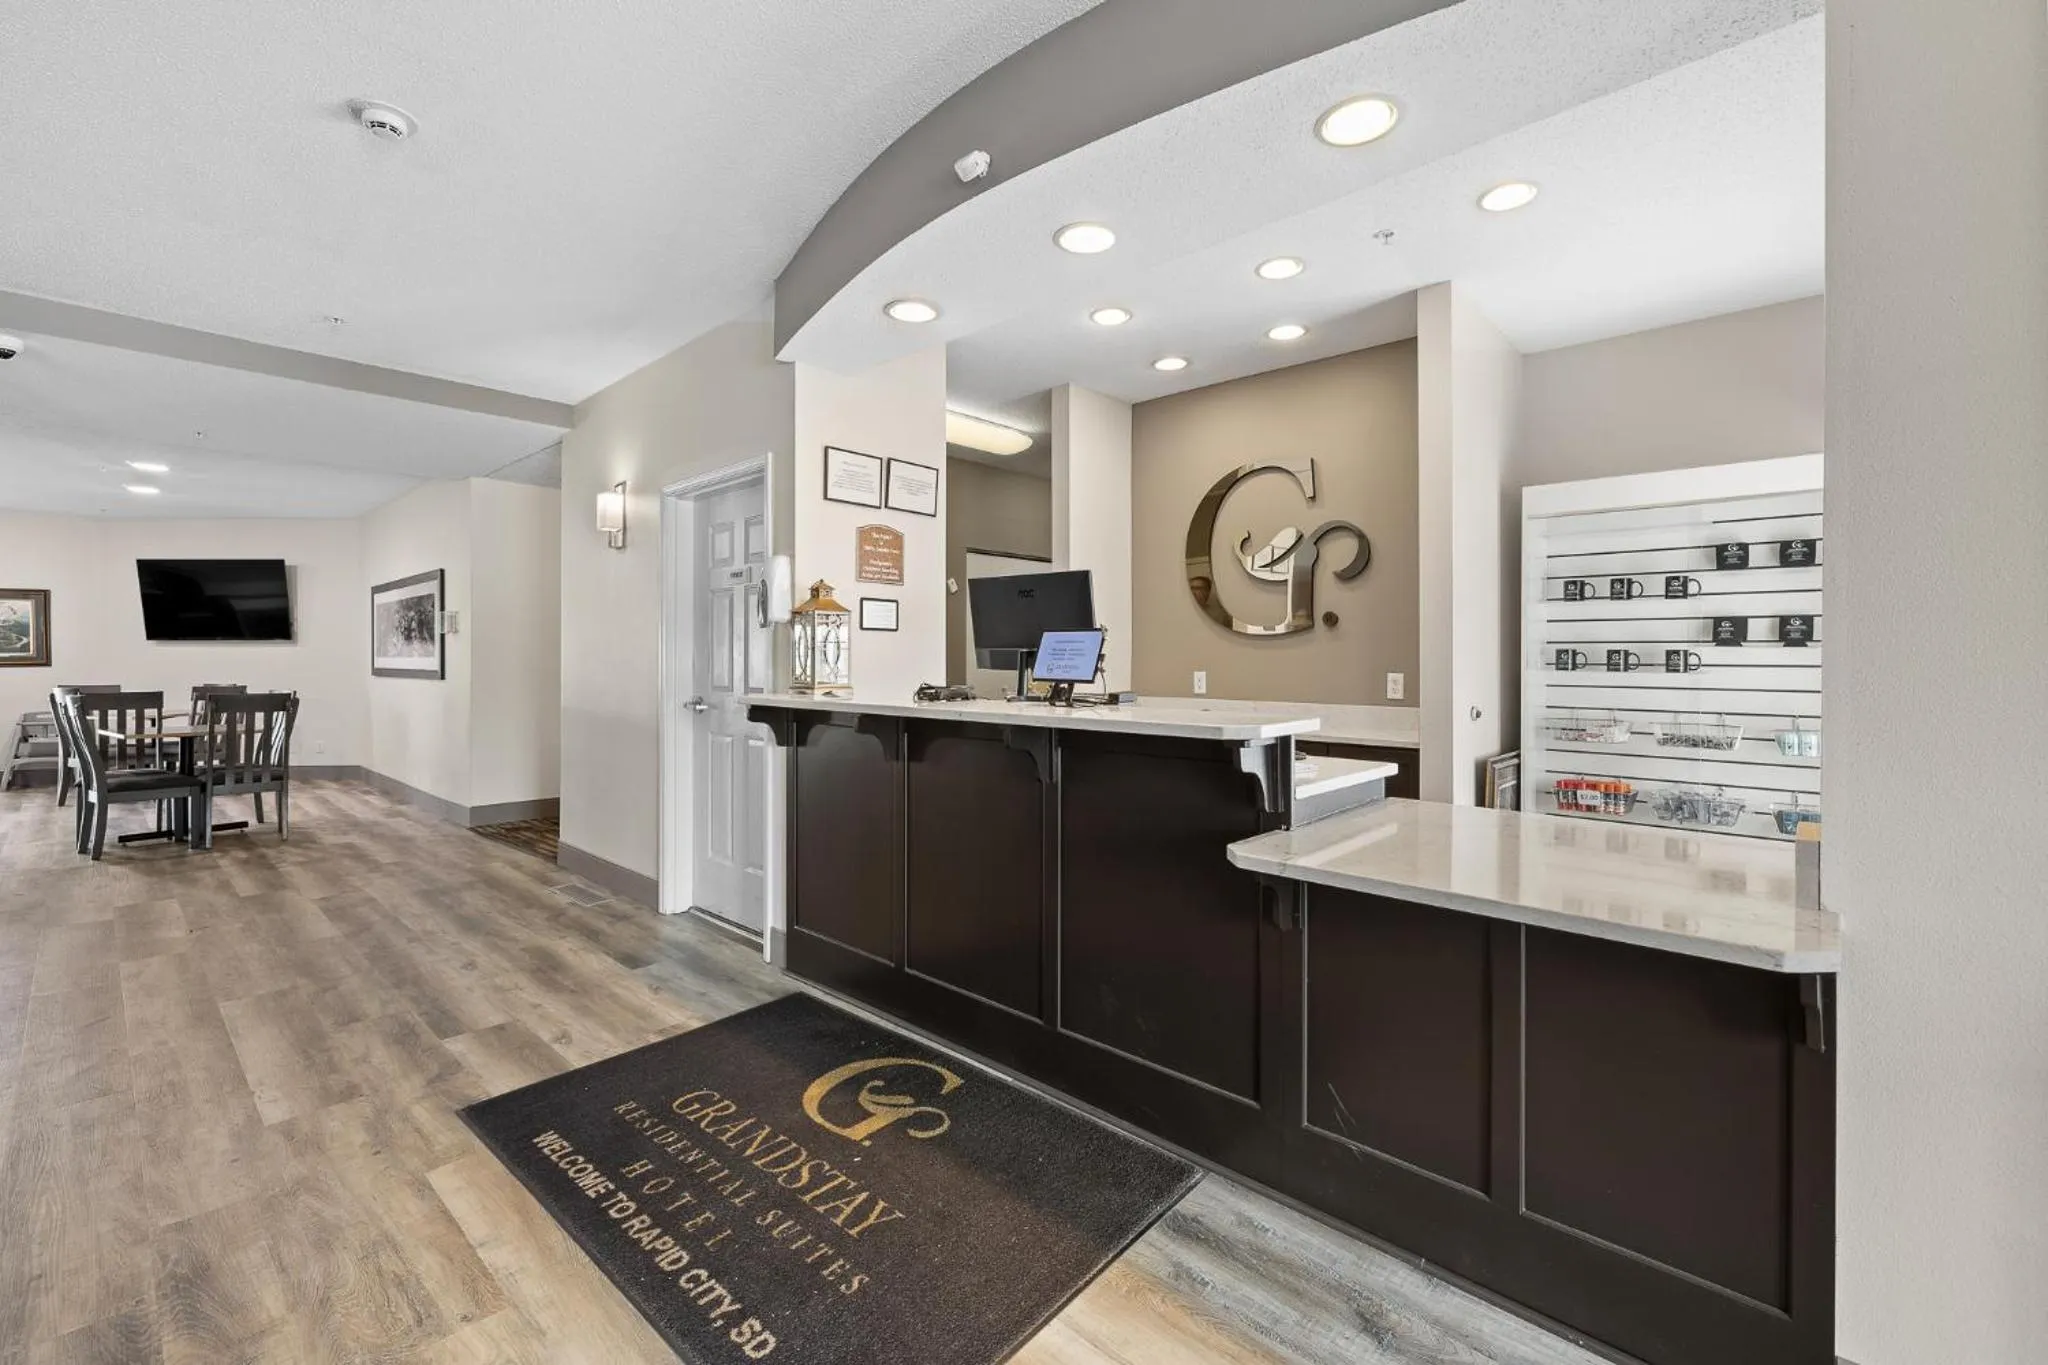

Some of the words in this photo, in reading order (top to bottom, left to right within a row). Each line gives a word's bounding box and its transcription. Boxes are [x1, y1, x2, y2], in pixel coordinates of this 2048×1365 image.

[532, 1130, 616, 1199] WELCOME
[599, 1191, 638, 1219] TO
[621, 1214, 691, 1271] RAPID
[678, 1268, 743, 1328] CITY,
[729, 1316, 777, 1360] SD
[613, 1100, 757, 1208] RESIDENTIAL
[755, 1210, 871, 1295] SUITES
[620, 1159, 733, 1252] HOTEL
[672, 1090, 905, 1239] GRANDSTAY
